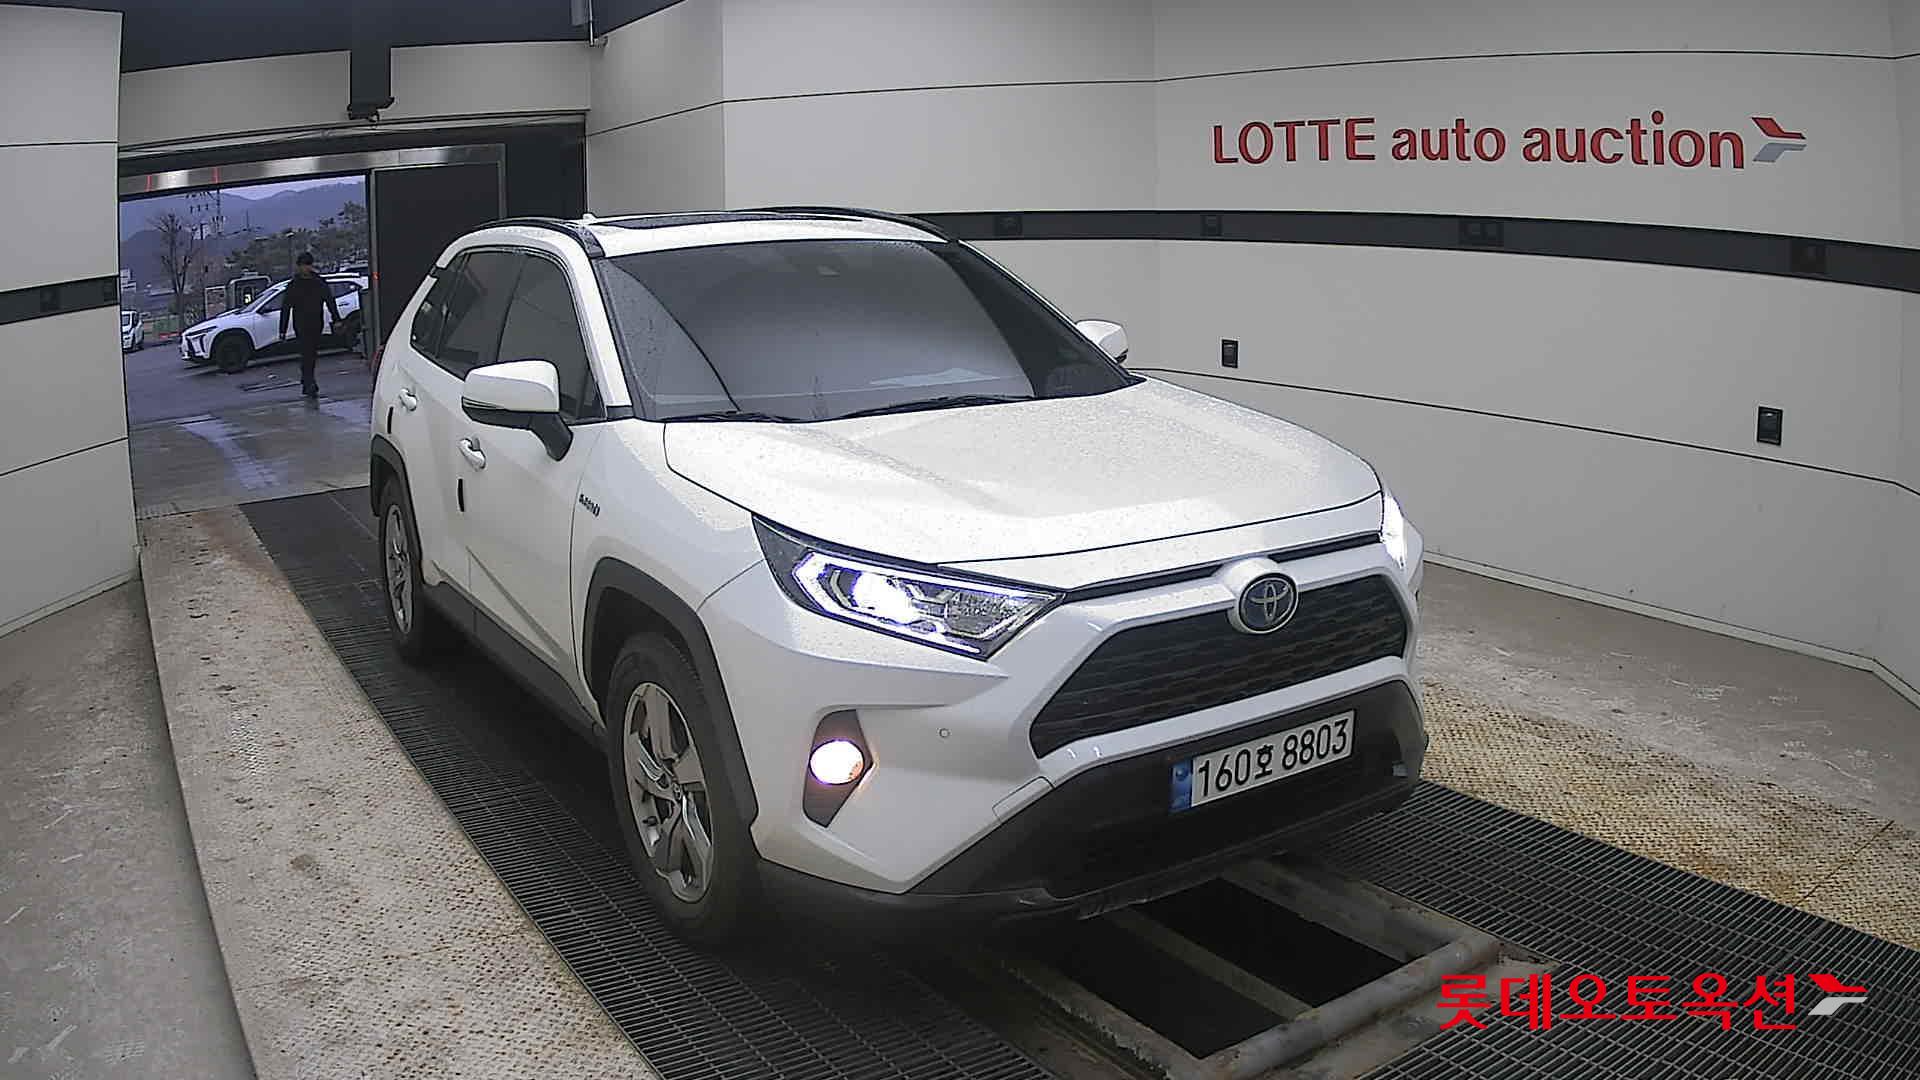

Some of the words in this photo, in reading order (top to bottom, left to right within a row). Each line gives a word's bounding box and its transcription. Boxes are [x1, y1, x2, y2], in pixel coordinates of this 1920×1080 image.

[1213, 117, 1376, 164] LOTTE
[1391, 118, 1507, 162] auto
[1522, 110, 1745, 169] auction
[1282, 718, 1349, 770] 8803
